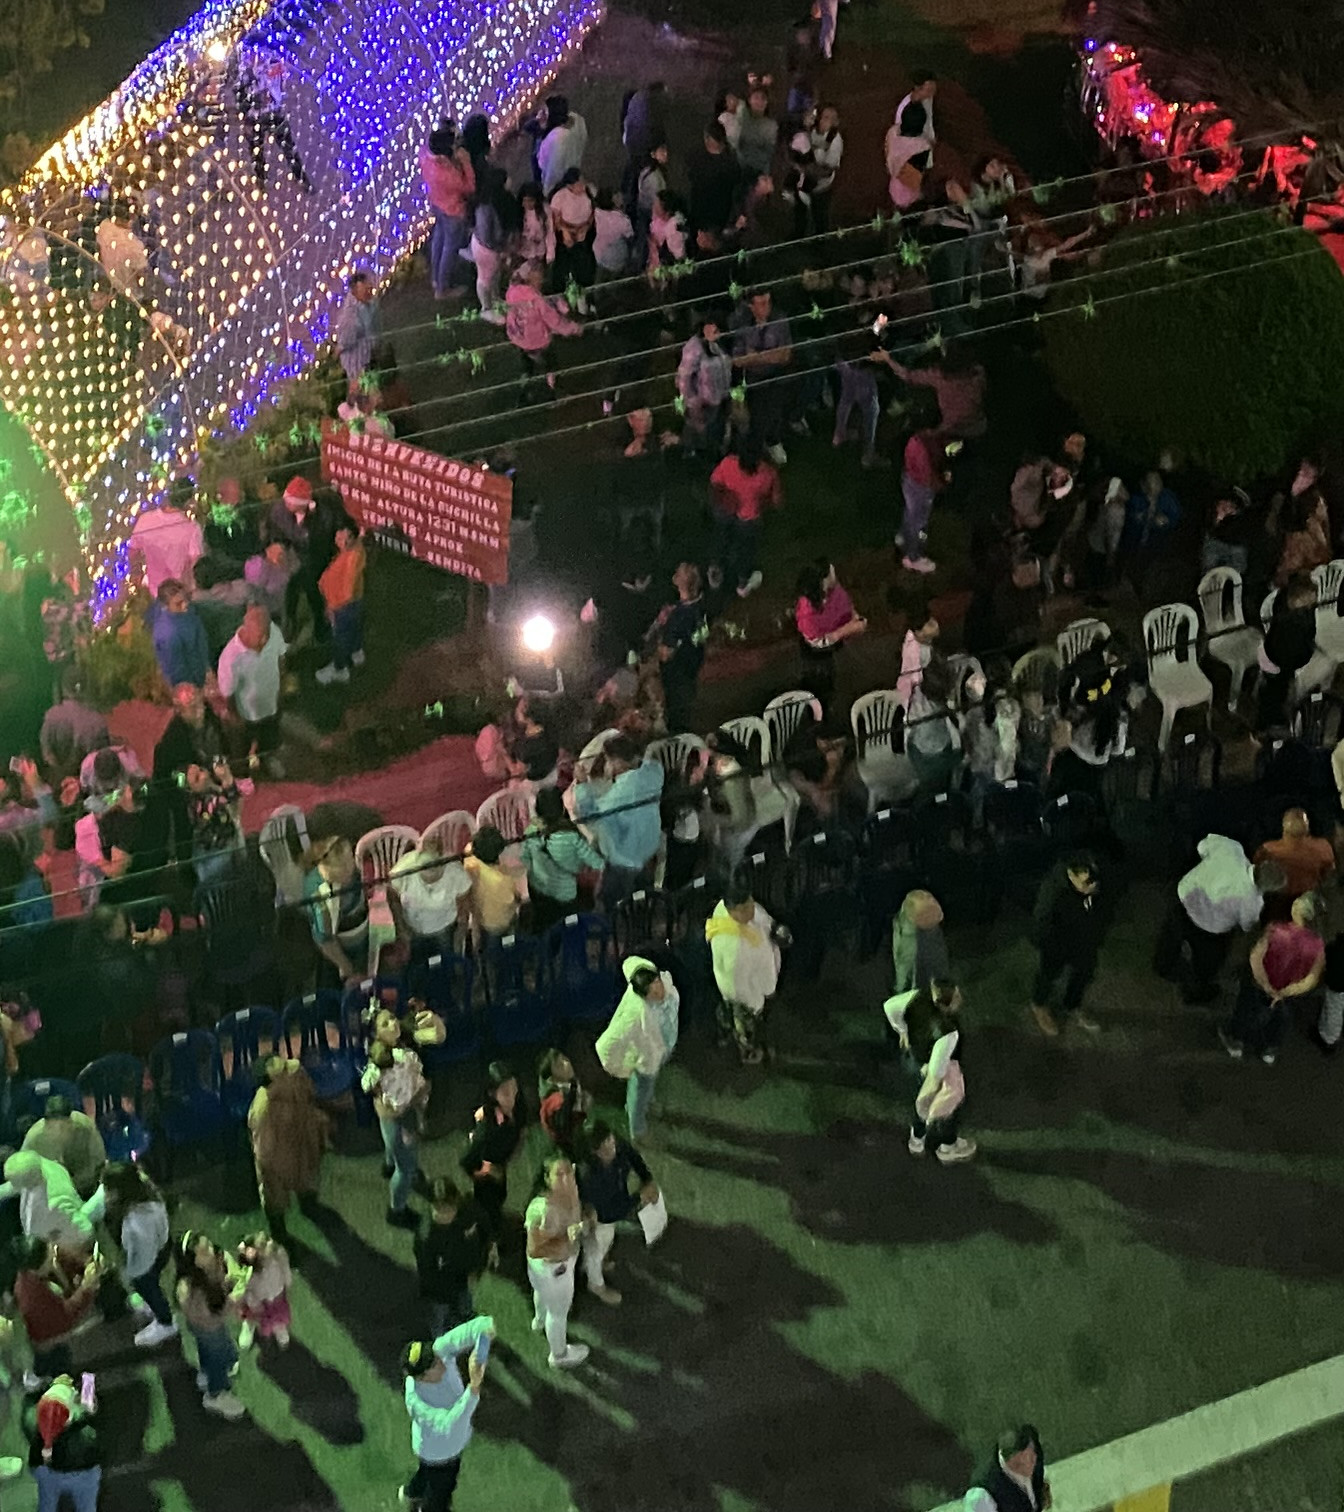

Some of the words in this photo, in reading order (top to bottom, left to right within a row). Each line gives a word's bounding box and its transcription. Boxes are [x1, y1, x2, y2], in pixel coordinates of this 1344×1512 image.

[327, 443, 365, 465] INICIO
[367, 458, 382, 475] DE
[402, 470, 431, 489] RUTA
[348, 433, 485, 488] BIENVENIDOS
[329, 462, 367, 483] SANTO
[403, 488, 418, 503] DE
[419, 494, 435, 509] LA
[438, 500, 500, 532] CUCHILLA
[377, 499, 424, 524] ALTURA
[424, 531, 464, 554] APROX
[426, 552, 482, 581] BENDITA
